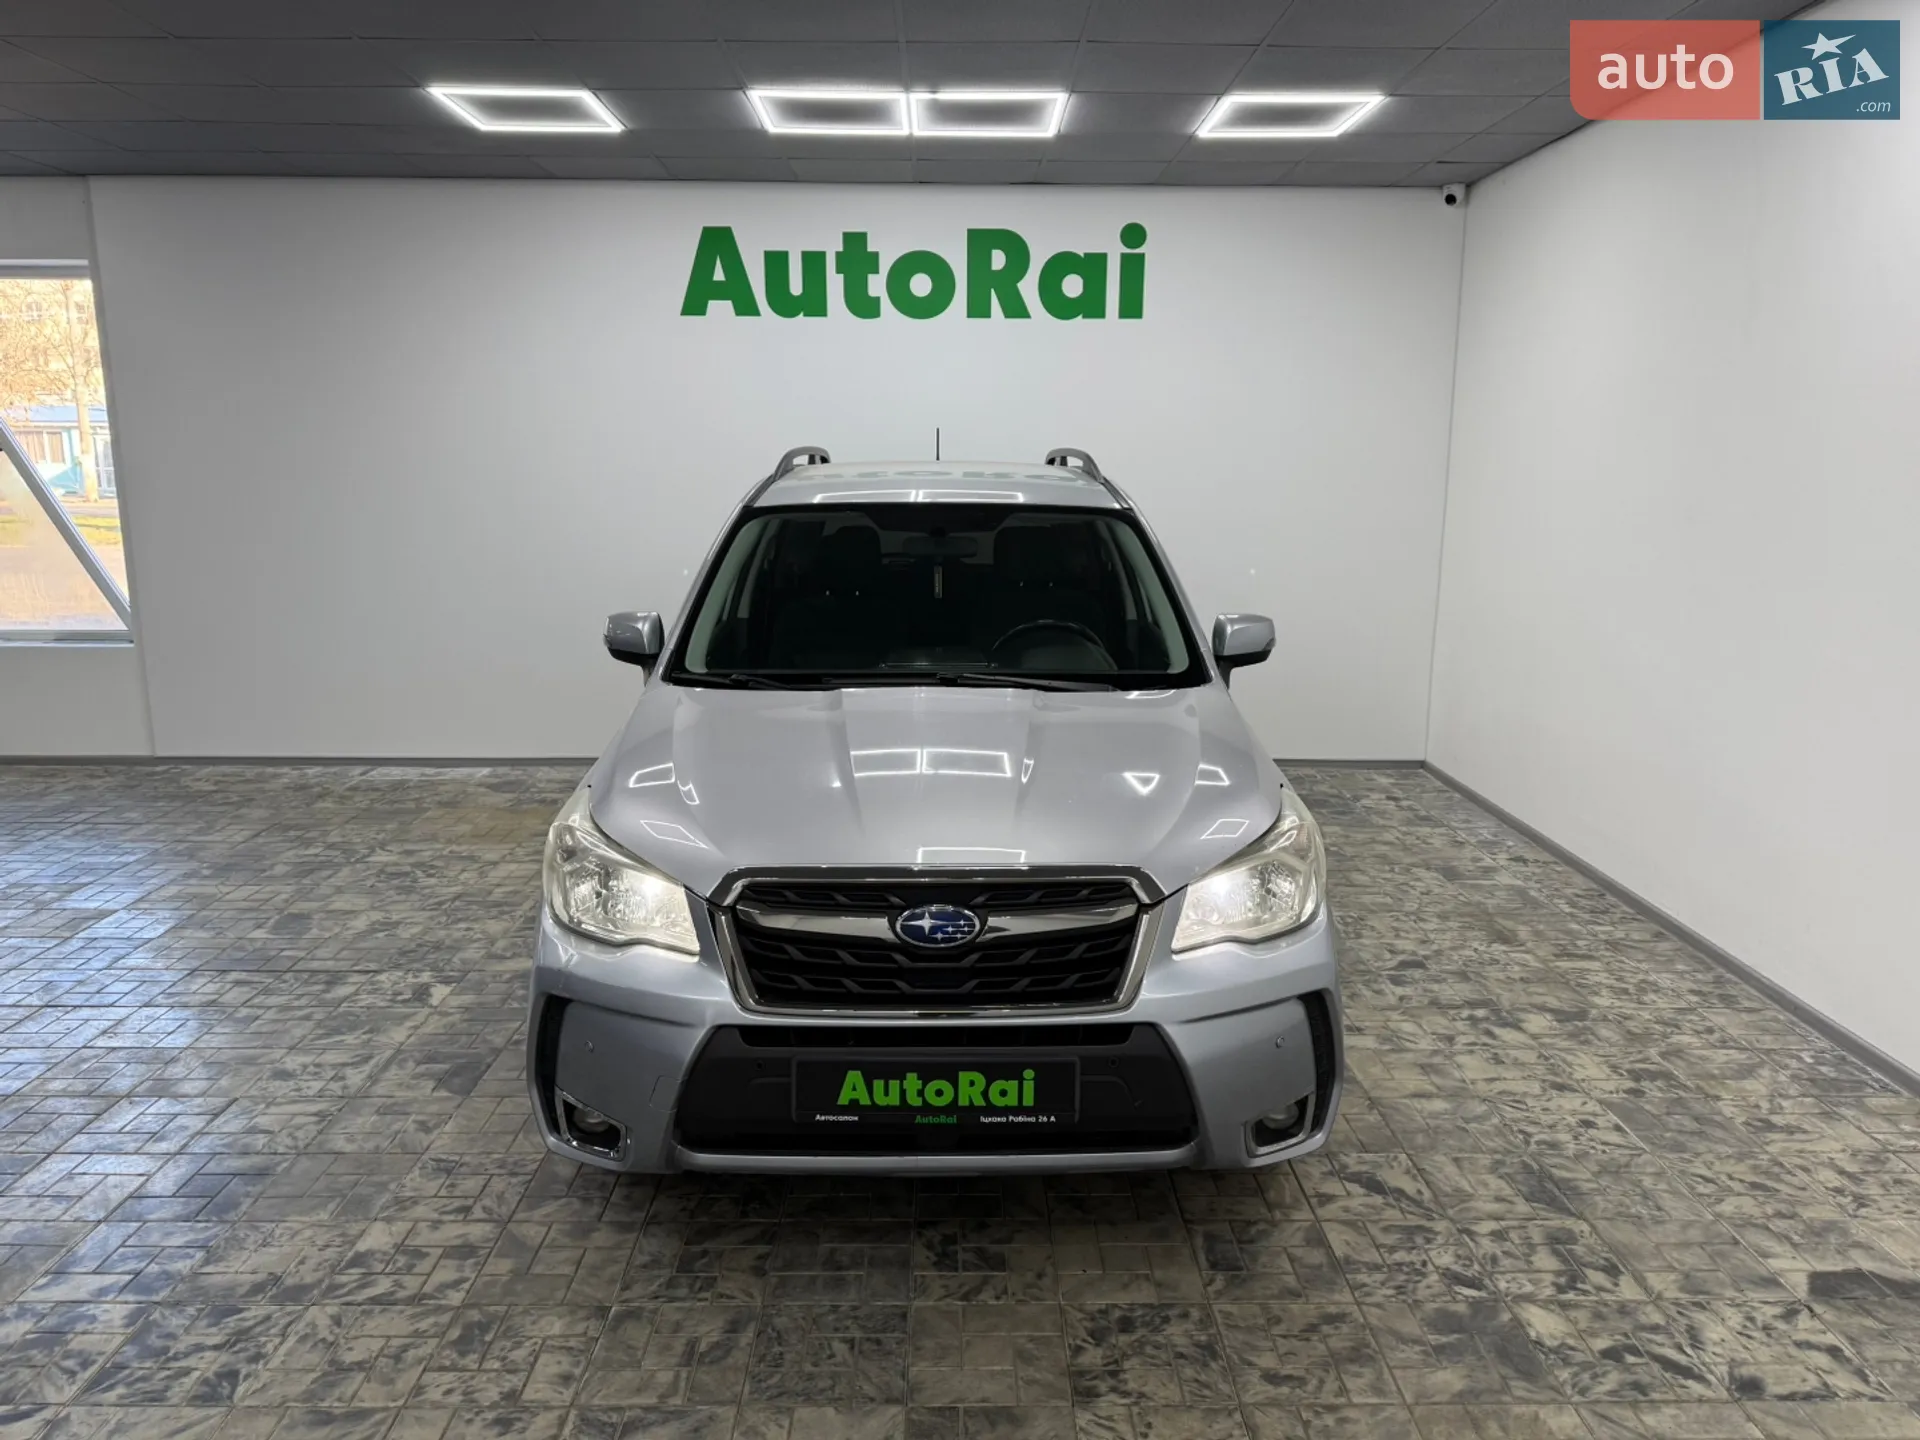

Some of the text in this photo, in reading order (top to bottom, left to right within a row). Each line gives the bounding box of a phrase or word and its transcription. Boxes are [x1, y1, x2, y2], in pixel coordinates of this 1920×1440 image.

[680, 222, 1148, 321] AutoRai
[836, 1069, 1036, 1107] AutoRai
[914, 1114, 958, 1125] AutoRai
